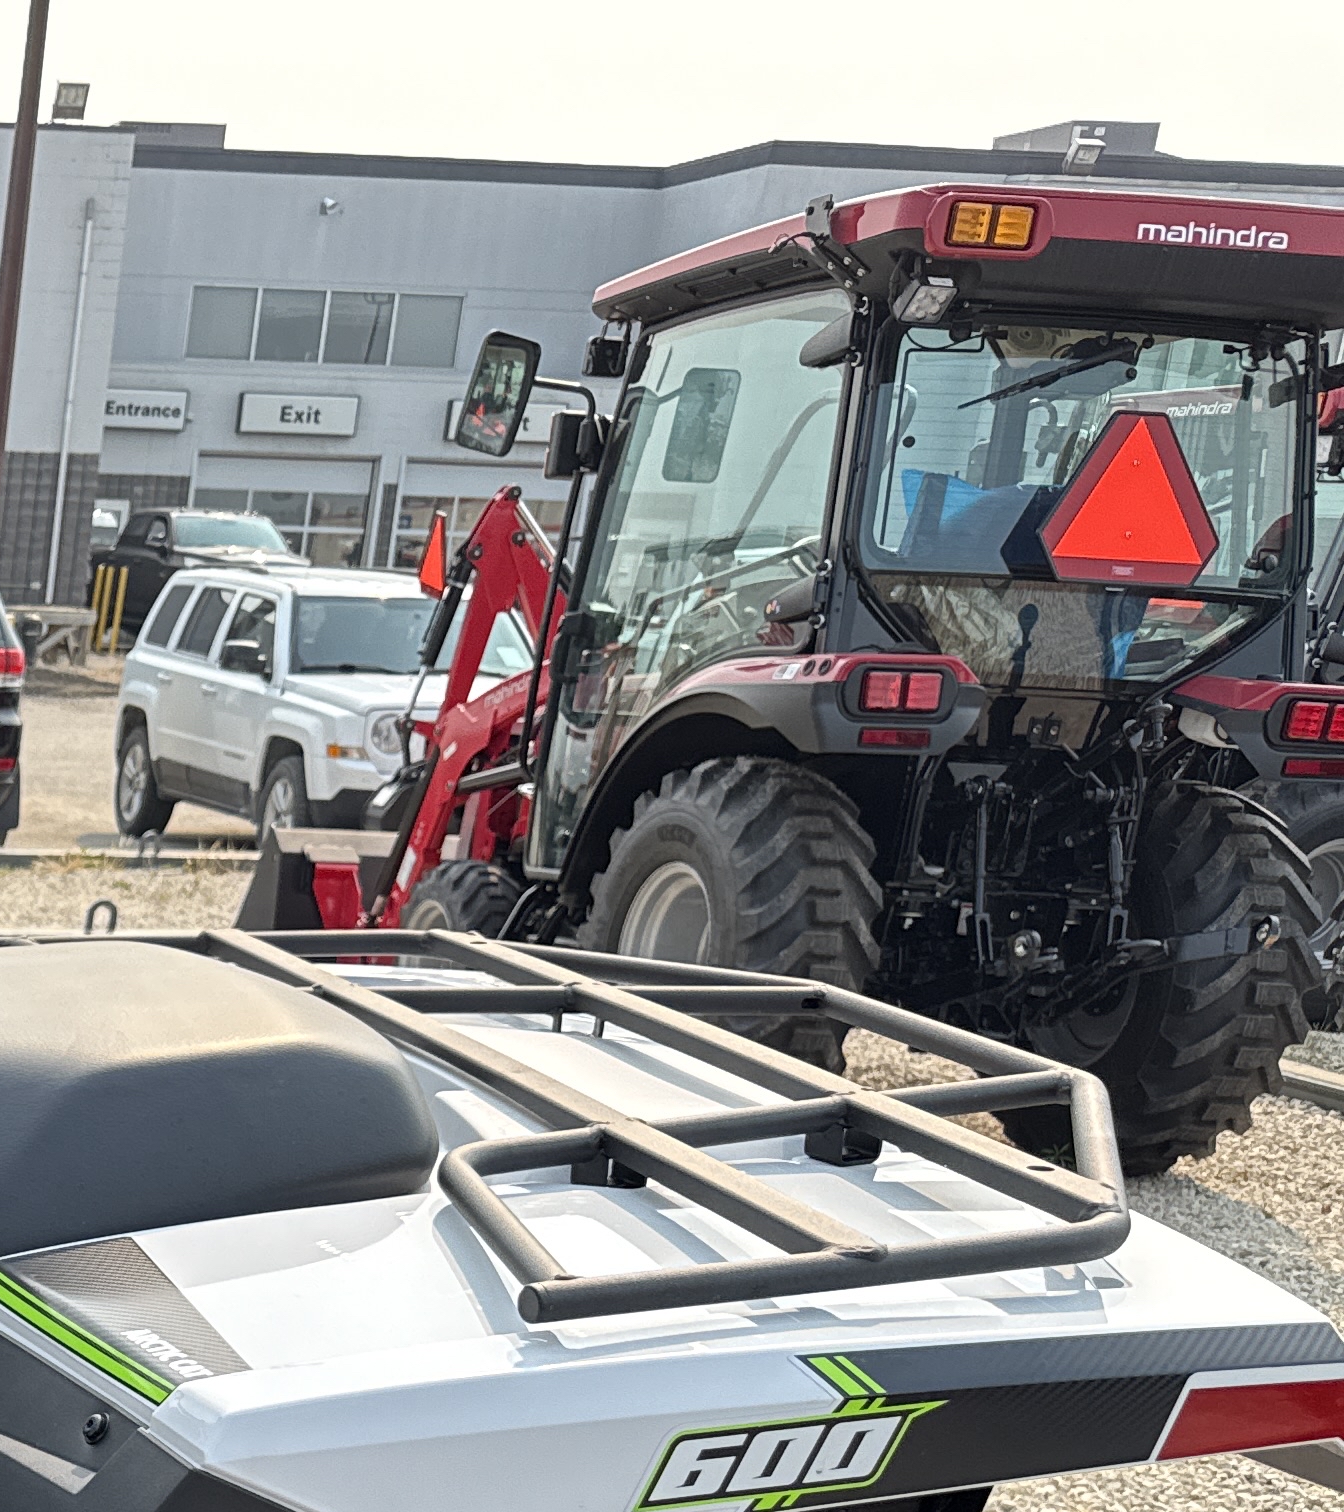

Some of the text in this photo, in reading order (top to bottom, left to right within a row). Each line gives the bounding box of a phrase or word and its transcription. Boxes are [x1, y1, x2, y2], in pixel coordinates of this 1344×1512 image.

[1137, 221, 1289, 250] mahindra
[104, 400, 182, 419] Entrance
[279, 404, 322, 425] Exit
[1166, 401, 1233, 418] mahindra
[646, 1411, 906, 1504] 600
